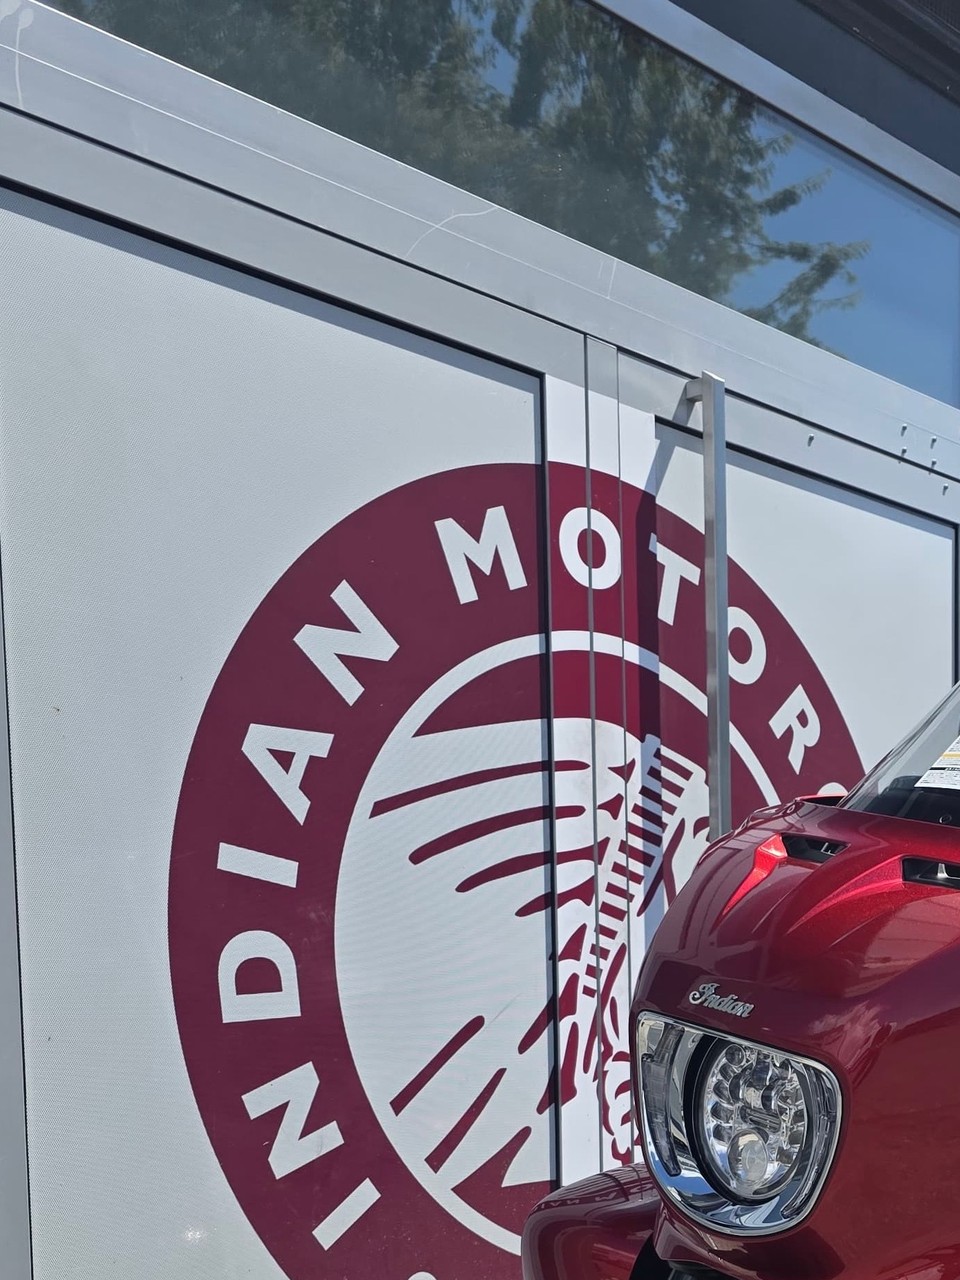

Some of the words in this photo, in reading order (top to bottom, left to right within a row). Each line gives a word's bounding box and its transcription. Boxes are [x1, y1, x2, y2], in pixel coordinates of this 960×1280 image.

[217, 579, 400, 1250] INDIAN
[434, 506, 848, 796] MOTOR
[688, 982, 755, 1018] Indian
